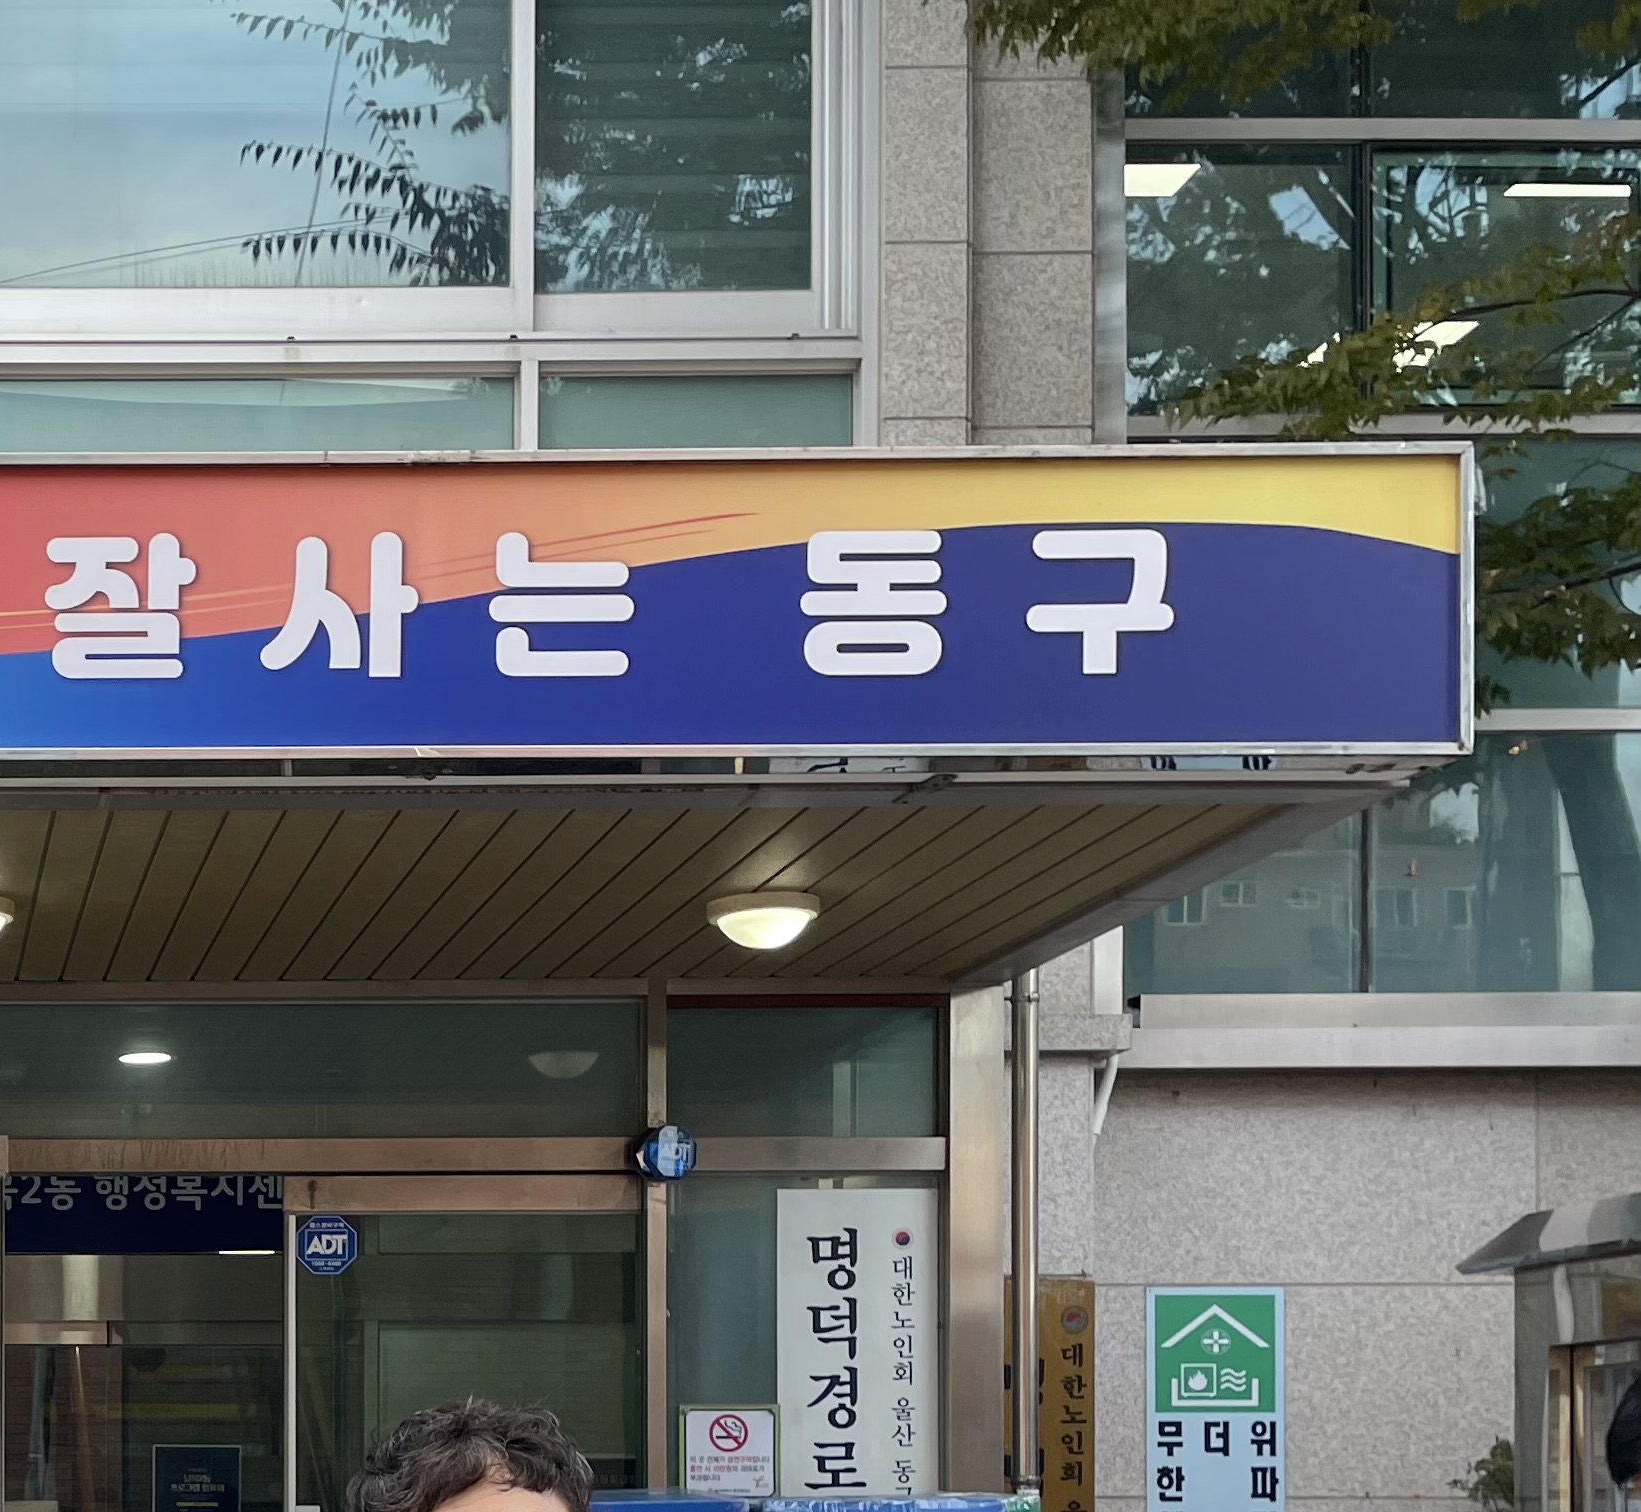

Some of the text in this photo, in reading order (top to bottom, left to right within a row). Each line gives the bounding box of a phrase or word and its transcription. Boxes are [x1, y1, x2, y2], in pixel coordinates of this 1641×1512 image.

[799, 528, 1175, 677] 동구
[305, 1234, 348, 1255] ADT
[804, 1227, 868, 1490] 명덕경로
[890, 1255, 916, 1386] 대한노인회
[890, 1396, 916, 1447] 울산
[1060, 1342, 1088, 1487] 대한노인회
